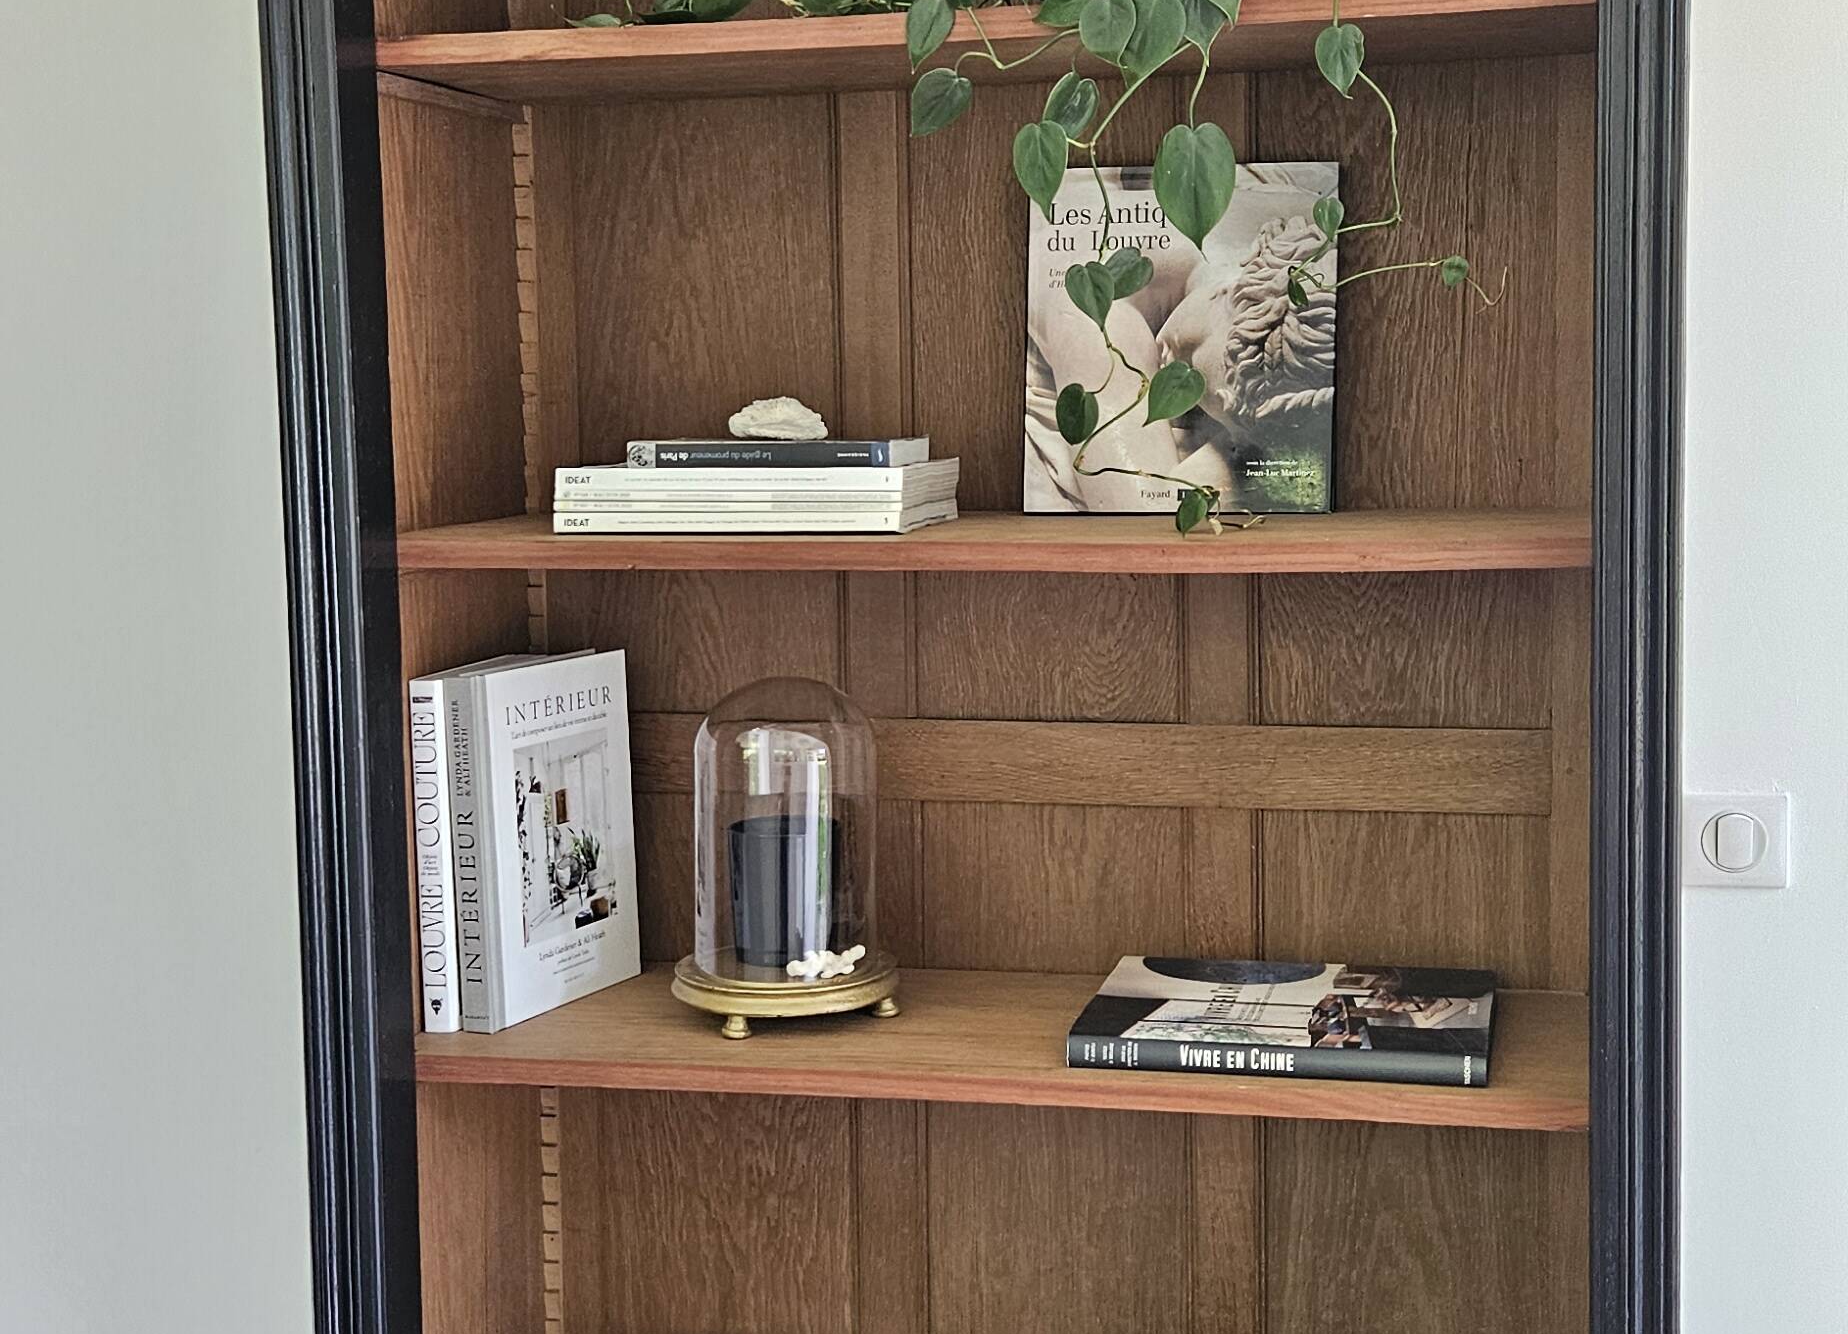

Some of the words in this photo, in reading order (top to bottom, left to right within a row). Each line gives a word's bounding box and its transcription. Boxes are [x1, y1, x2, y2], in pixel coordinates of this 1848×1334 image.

[1050, 203, 1091, 225] Les
[1097, 201, 1168, 228] Antiq
[1047, 230, 1076, 251] du
[1091, 230, 1171, 250] Louvre
[660, 451, 678, 461] Paris
[565, 476, 591, 484] IDEAT
[1246, 468, 1280, 477] Jean-Luc
[1140, 490, 1171, 499] Fayard
[563, 518, 589, 527] IDEAT
[505, 685, 612, 725] INTÉRIEUR
[451, 700, 461, 758] GARDENER
[461, 728, 469, 765] HEATH
[412, 712, 441, 847] COUTURE
[455, 762, 463, 796] LYNDA
[463, 768, 471, 786] ALI
[457, 810, 483, 984] INTÉRIEUR
[420, 884, 447, 988] LOUVRE
[1180, 1044, 1221, 1068] VIVRE
[1227, 1051, 1245, 1069] EN
[1250, 1048, 1294, 1071] CHINE
